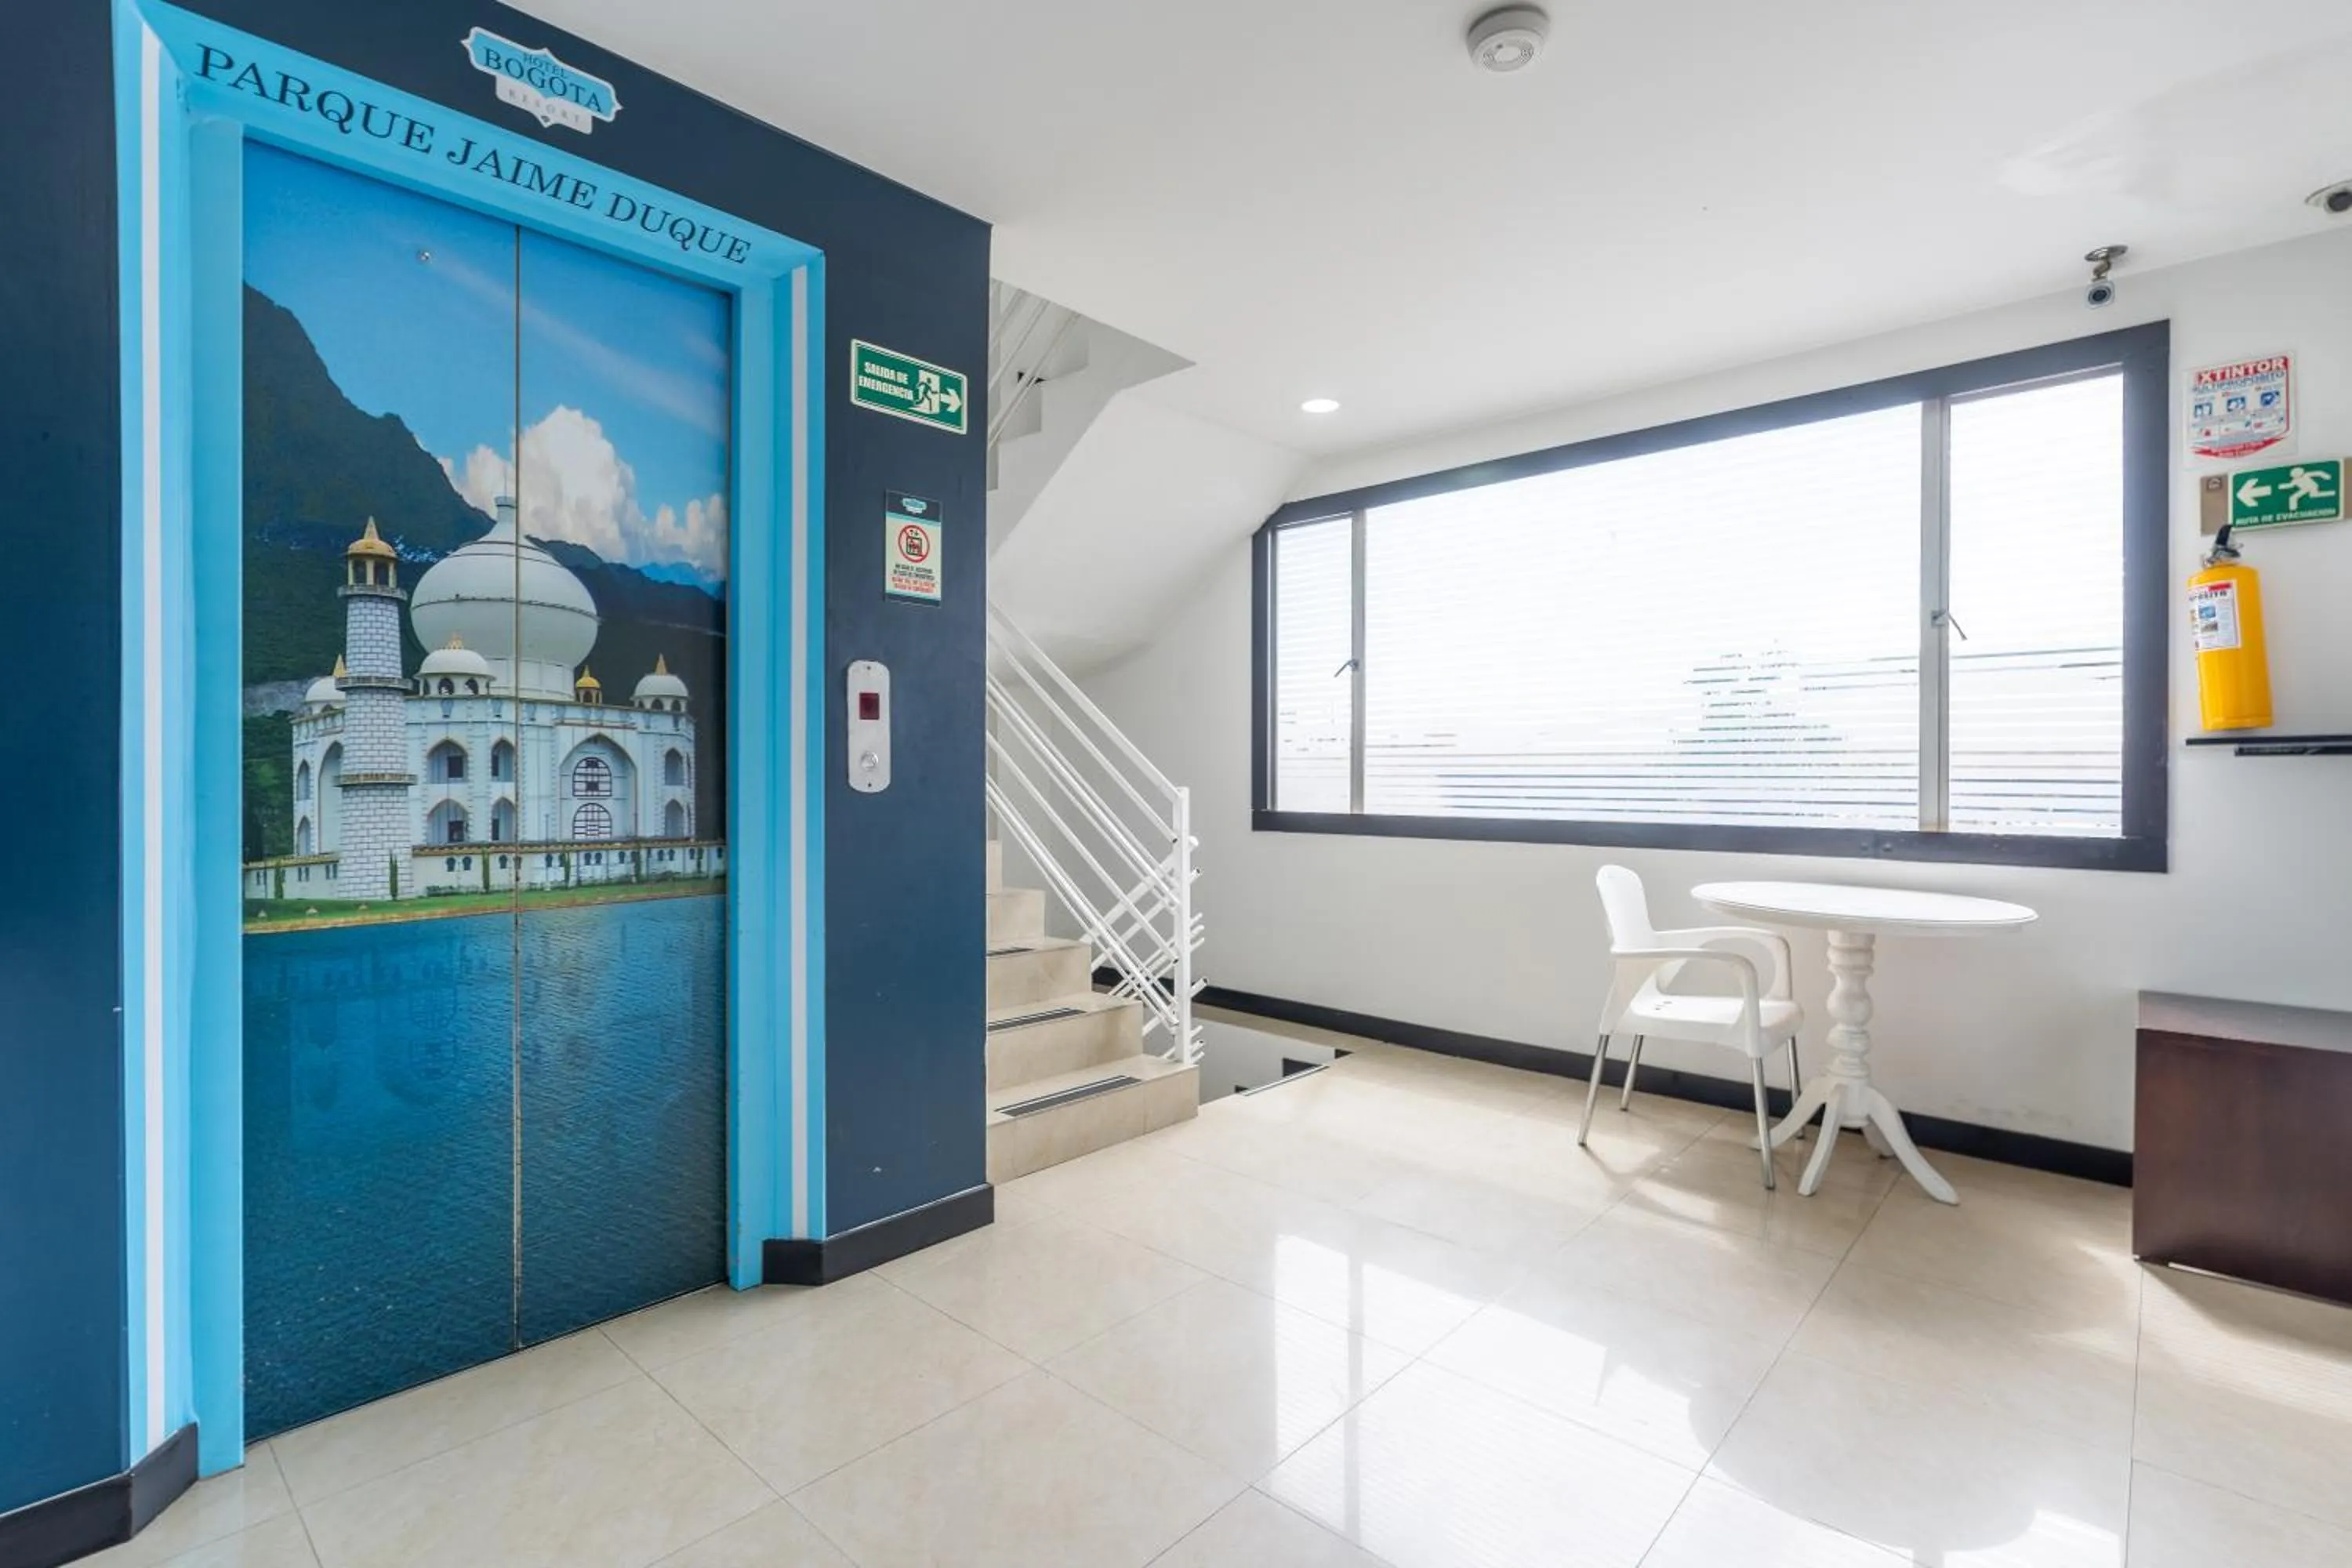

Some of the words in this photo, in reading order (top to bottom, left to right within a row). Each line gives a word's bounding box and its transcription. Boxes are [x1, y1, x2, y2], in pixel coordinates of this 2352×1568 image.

[523, 53, 567, 78] HOTEL
[484, 46, 603, 114] BOGOTA
[194, 43, 435, 154] PARQUE
[447, 137, 598, 210] JAIME
[605, 191, 752, 264] DUQUE
[865, 361, 896, 382] SALIDA
[896, 371, 909, 384] DE
[858, 376, 913, 401] EMERGENCIA
